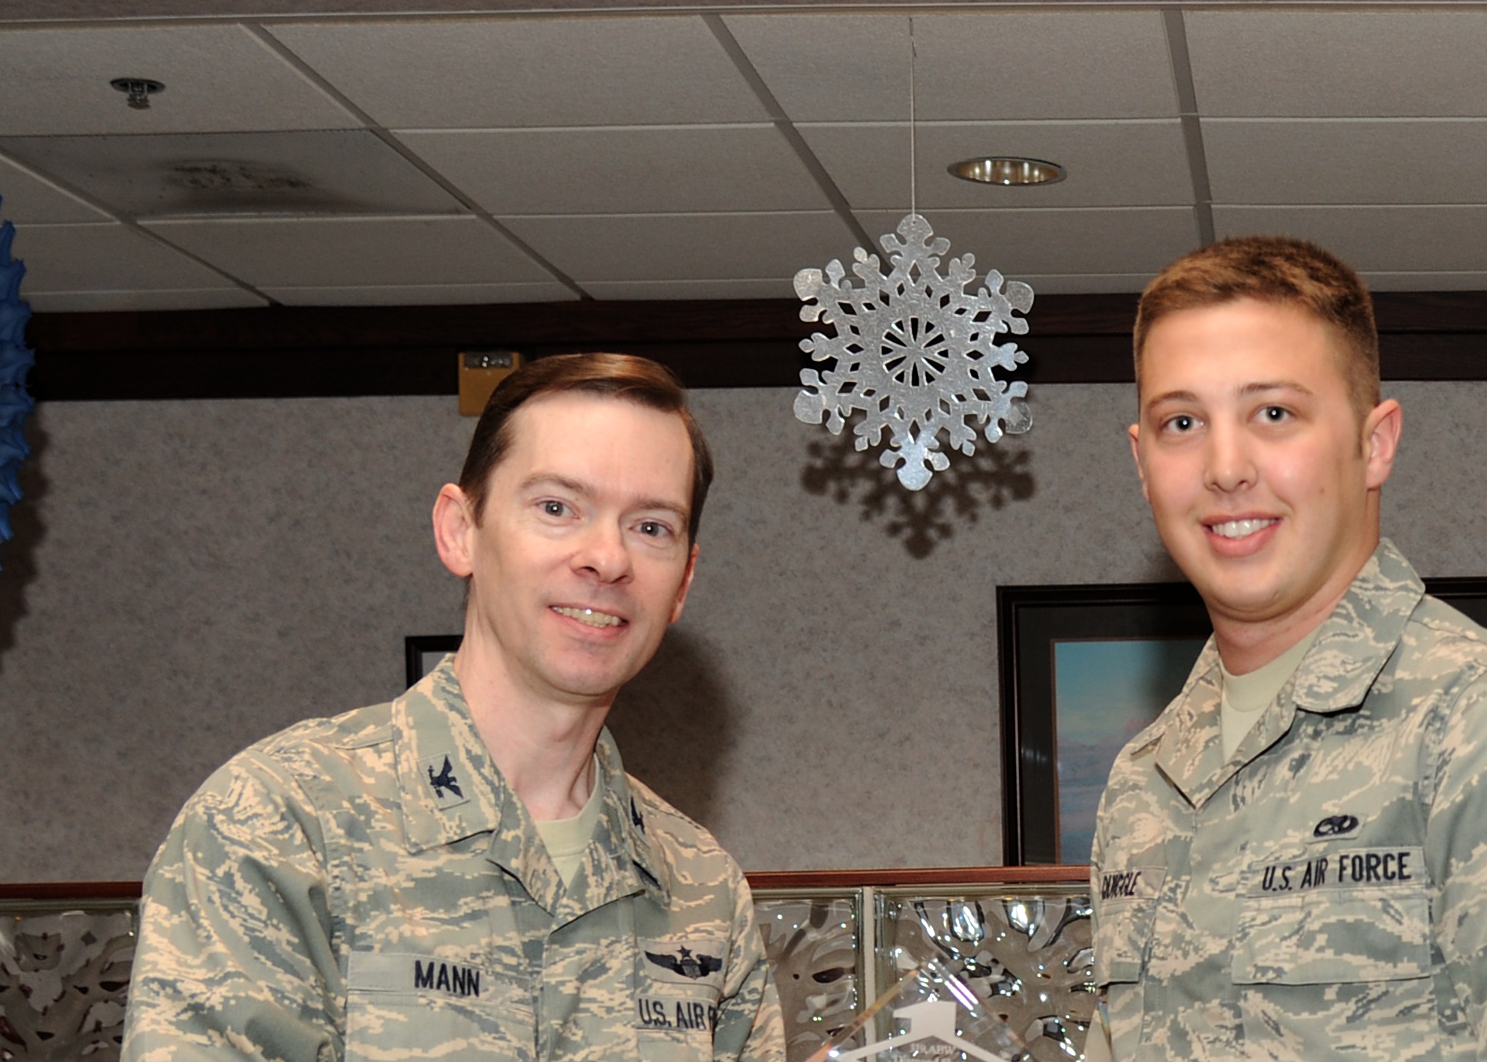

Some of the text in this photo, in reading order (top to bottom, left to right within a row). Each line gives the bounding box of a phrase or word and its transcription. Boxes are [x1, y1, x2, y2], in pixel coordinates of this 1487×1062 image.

[1262, 852, 1412, 892] U.S. AIR FORCE
[414, 960, 480, 998] MANN
[638, 998, 672, 1027] U.S.
[676, 1001, 707, 1030] AIR
